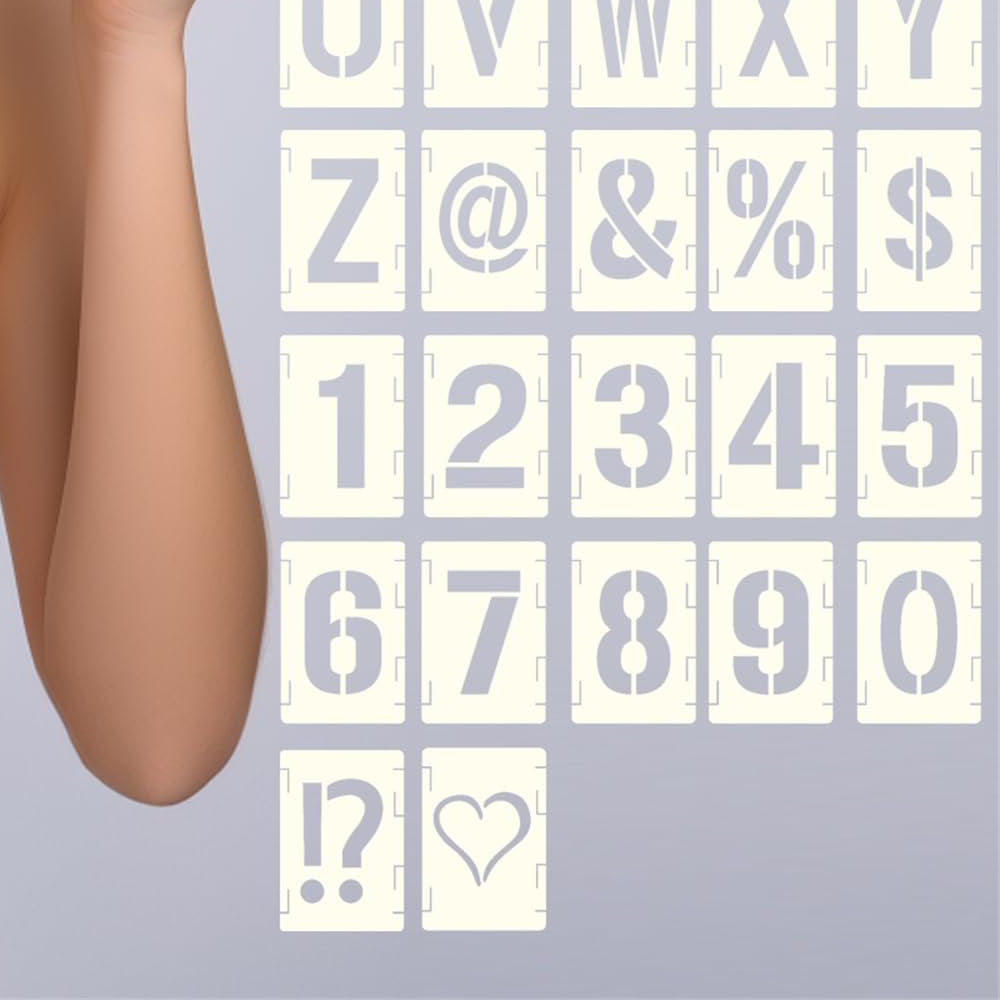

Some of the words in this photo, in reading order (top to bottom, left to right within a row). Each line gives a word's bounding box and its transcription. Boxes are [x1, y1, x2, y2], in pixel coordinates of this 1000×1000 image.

[308, 159, 378, 282] Z
[440, 163, 527, 272] @
[591, 159, 676, 279] &
[728, 160, 814, 279] %
[887, 157, 952, 279] $
[319, 365, 365, 488] 1
[446, 365, 526, 488] 2
[595, 365, 672, 488] 3
[728, 363, 819, 488] 4
[882, 365, 957, 487] 5
[305, 571, 381, 693] 6
[448, 570, 520, 695] 7
[598, 571, 670, 695] 8
[733, 571, 808, 695] 9
[881, 571, 957, 694] 0
[301, 779, 382, 904] !?
